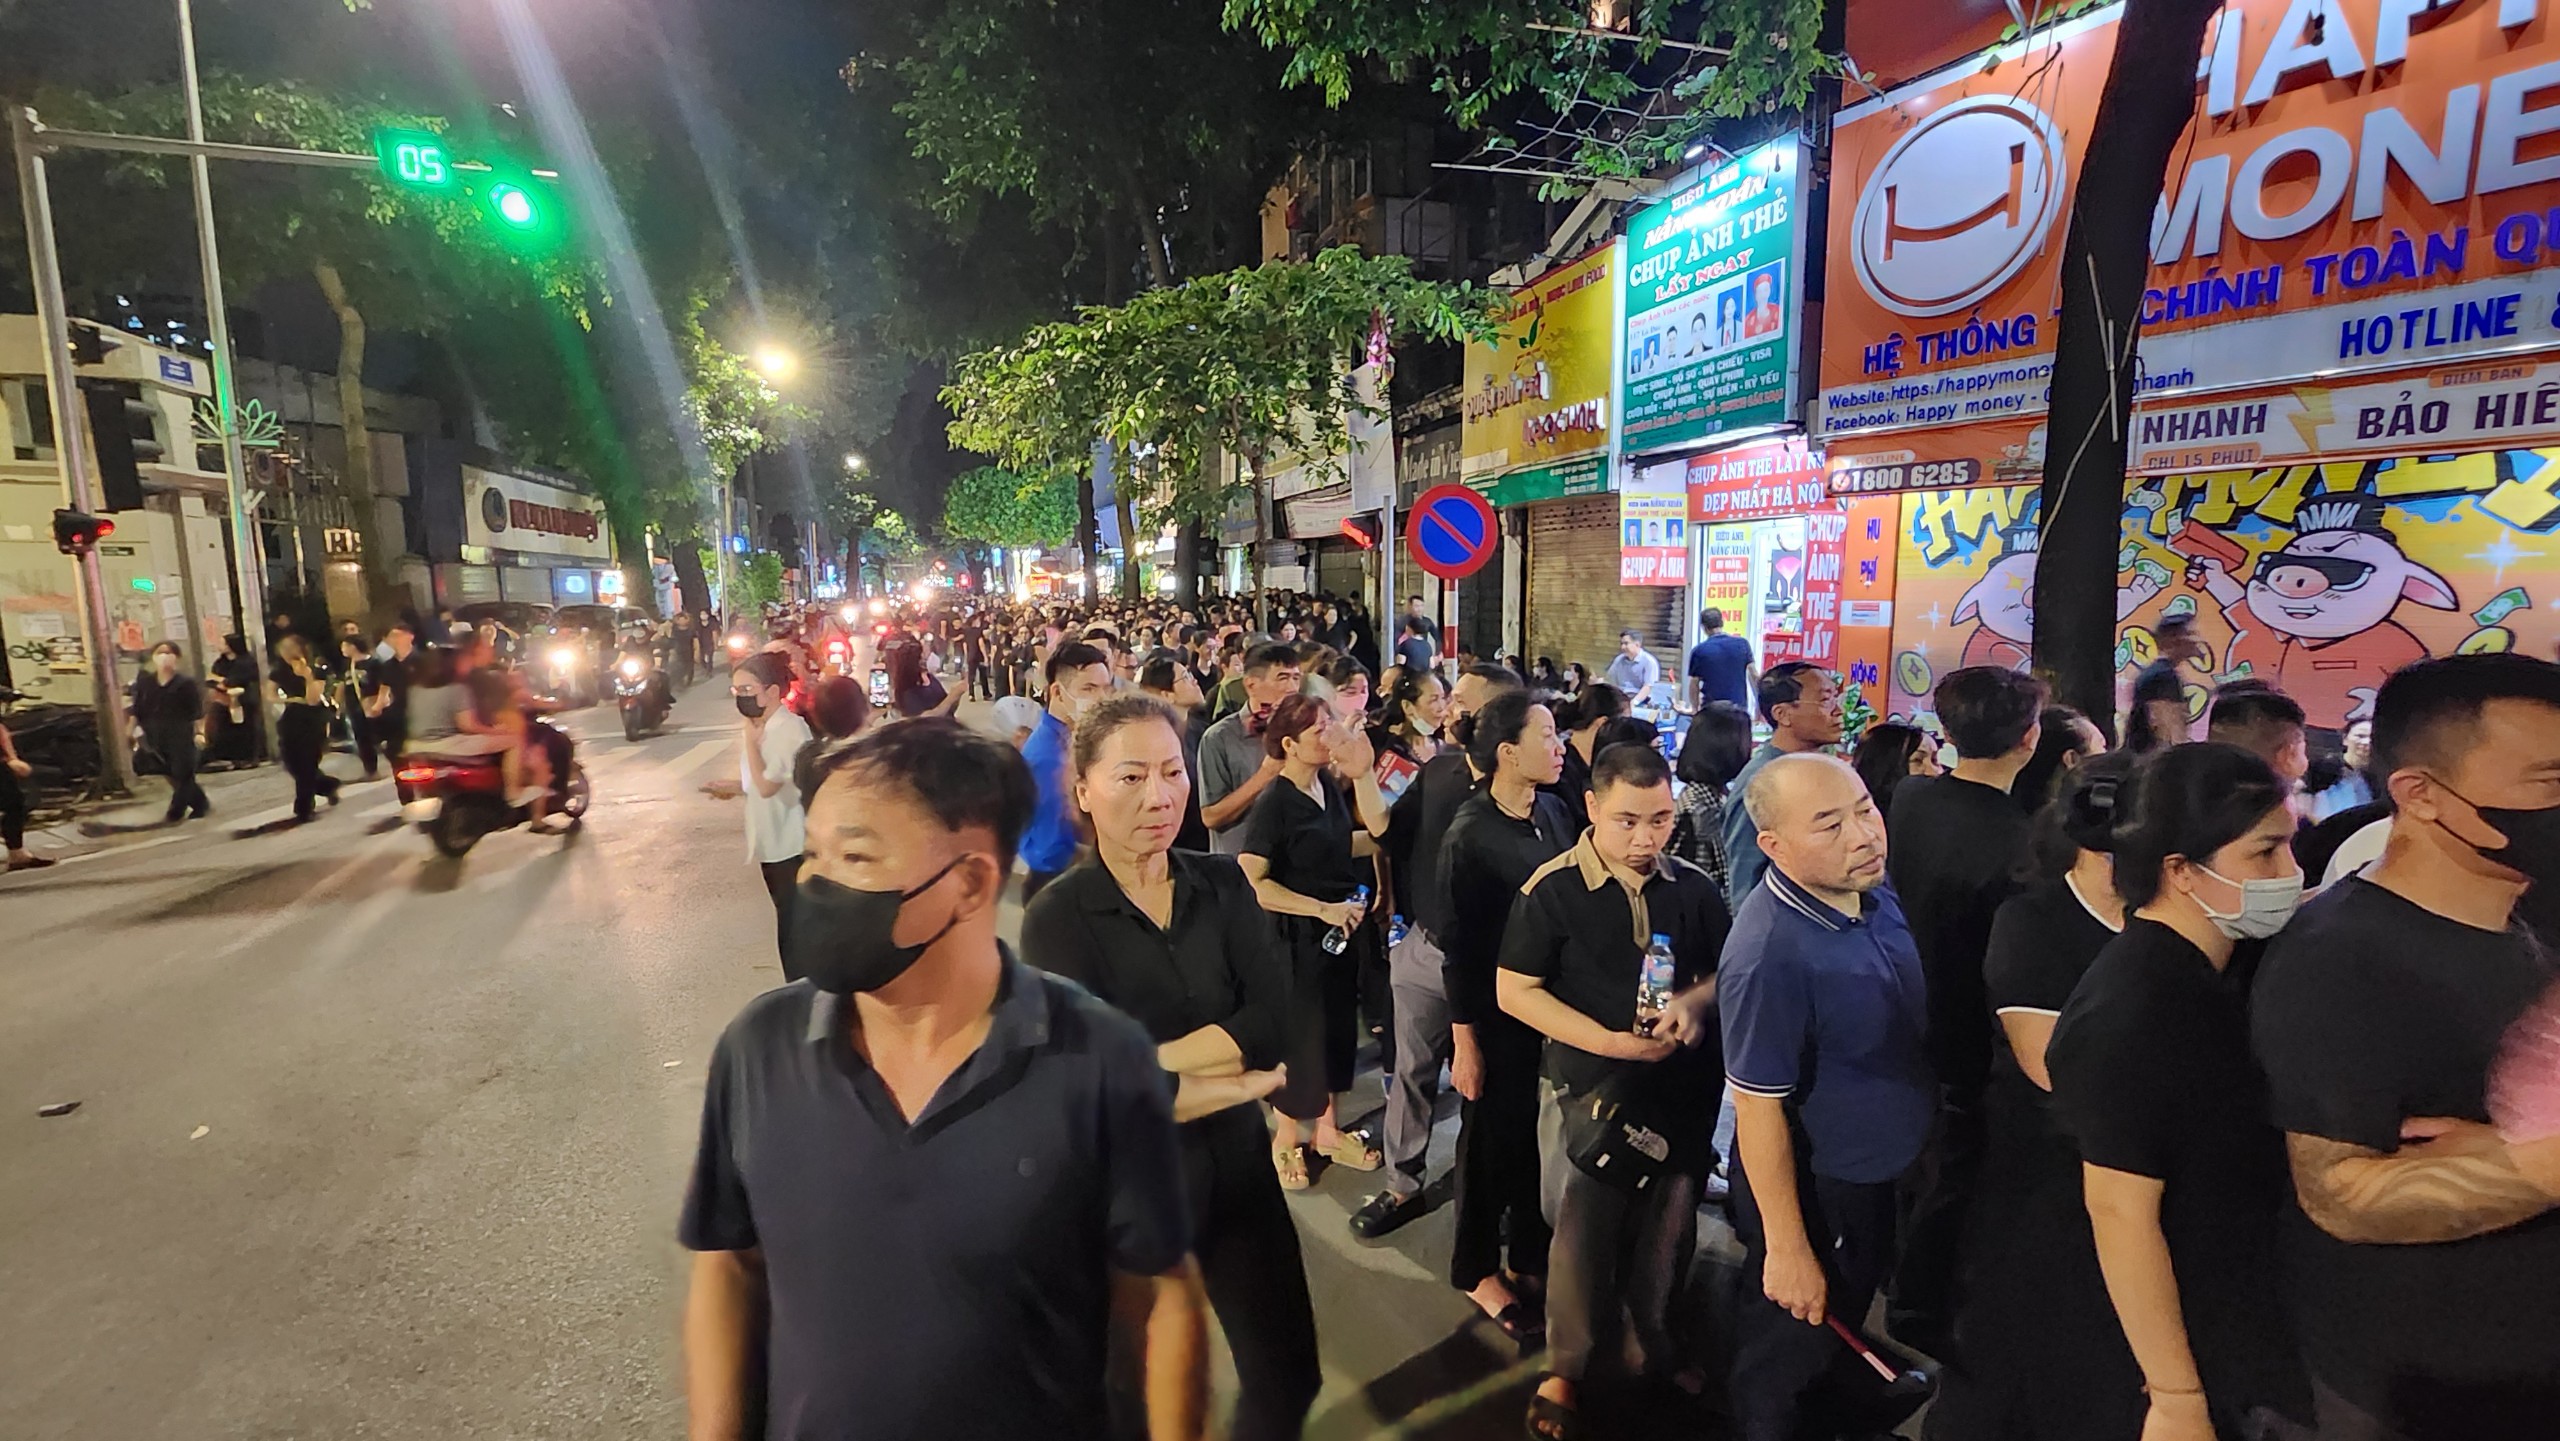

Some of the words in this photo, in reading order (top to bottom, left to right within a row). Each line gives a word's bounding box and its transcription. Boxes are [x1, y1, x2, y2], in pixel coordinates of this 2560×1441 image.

[397, 144, 446, 184] 05
[1630, 246, 1682, 287] CHỤP
[1685, 220, 1734, 264] ẢNH
[1739, 187, 1787, 239] THẺ
[1655, 270, 1694, 302] LẤY
[1695, 248, 1754, 285] NGAY
[2140, 265, 2282, 325] CHÍNH
[2305, 227, 2469, 296] TOÀN
[1863, 332, 1905, 378] HỆ
[1915, 307, 2038, 365] THỐNG
[2340, 293, 2521, 359] HOTLINE
[1716, 353, 1744, 371] CHIẾU
[1750, 347, 1772, 363] VISA
[1825, 409, 1900, 432] Facebook:
[1906, 403, 1958, 422] Happy
[1965, 392, 2026, 414] money
[2142, 404, 2268, 444] NHANH
[2357, 390, 2449, 441] BẢO
[1687, 464, 1717, 487] CHỤP
[1719, 456, 1745, 481] ẢNH
[1852, 467, 1903, 491] 1800
[1910, 461, 1969, 487] 6285
[1703, 492, 1728, 516] ĐẸP
[1731, 479, 1770, 510] NHẤT
[1772, 479, 1793, 506] HÀ
[1797, 477, 1825, 508] NỘI
[1808, 514, 1847, 550] CHỤP
[1623, 556, 1656, 583] CHỤP
[1658, 549, 1685, 578] ẢNH
[1807, 543, 1840, 581] ẢNH
[1707, 586, 1749, 603] CHỤP
[1806, 583, 1836, 620] THẺ
[1722, 610, 1743, 622] NH
[1802, 622, 1834, 659] LẤY
